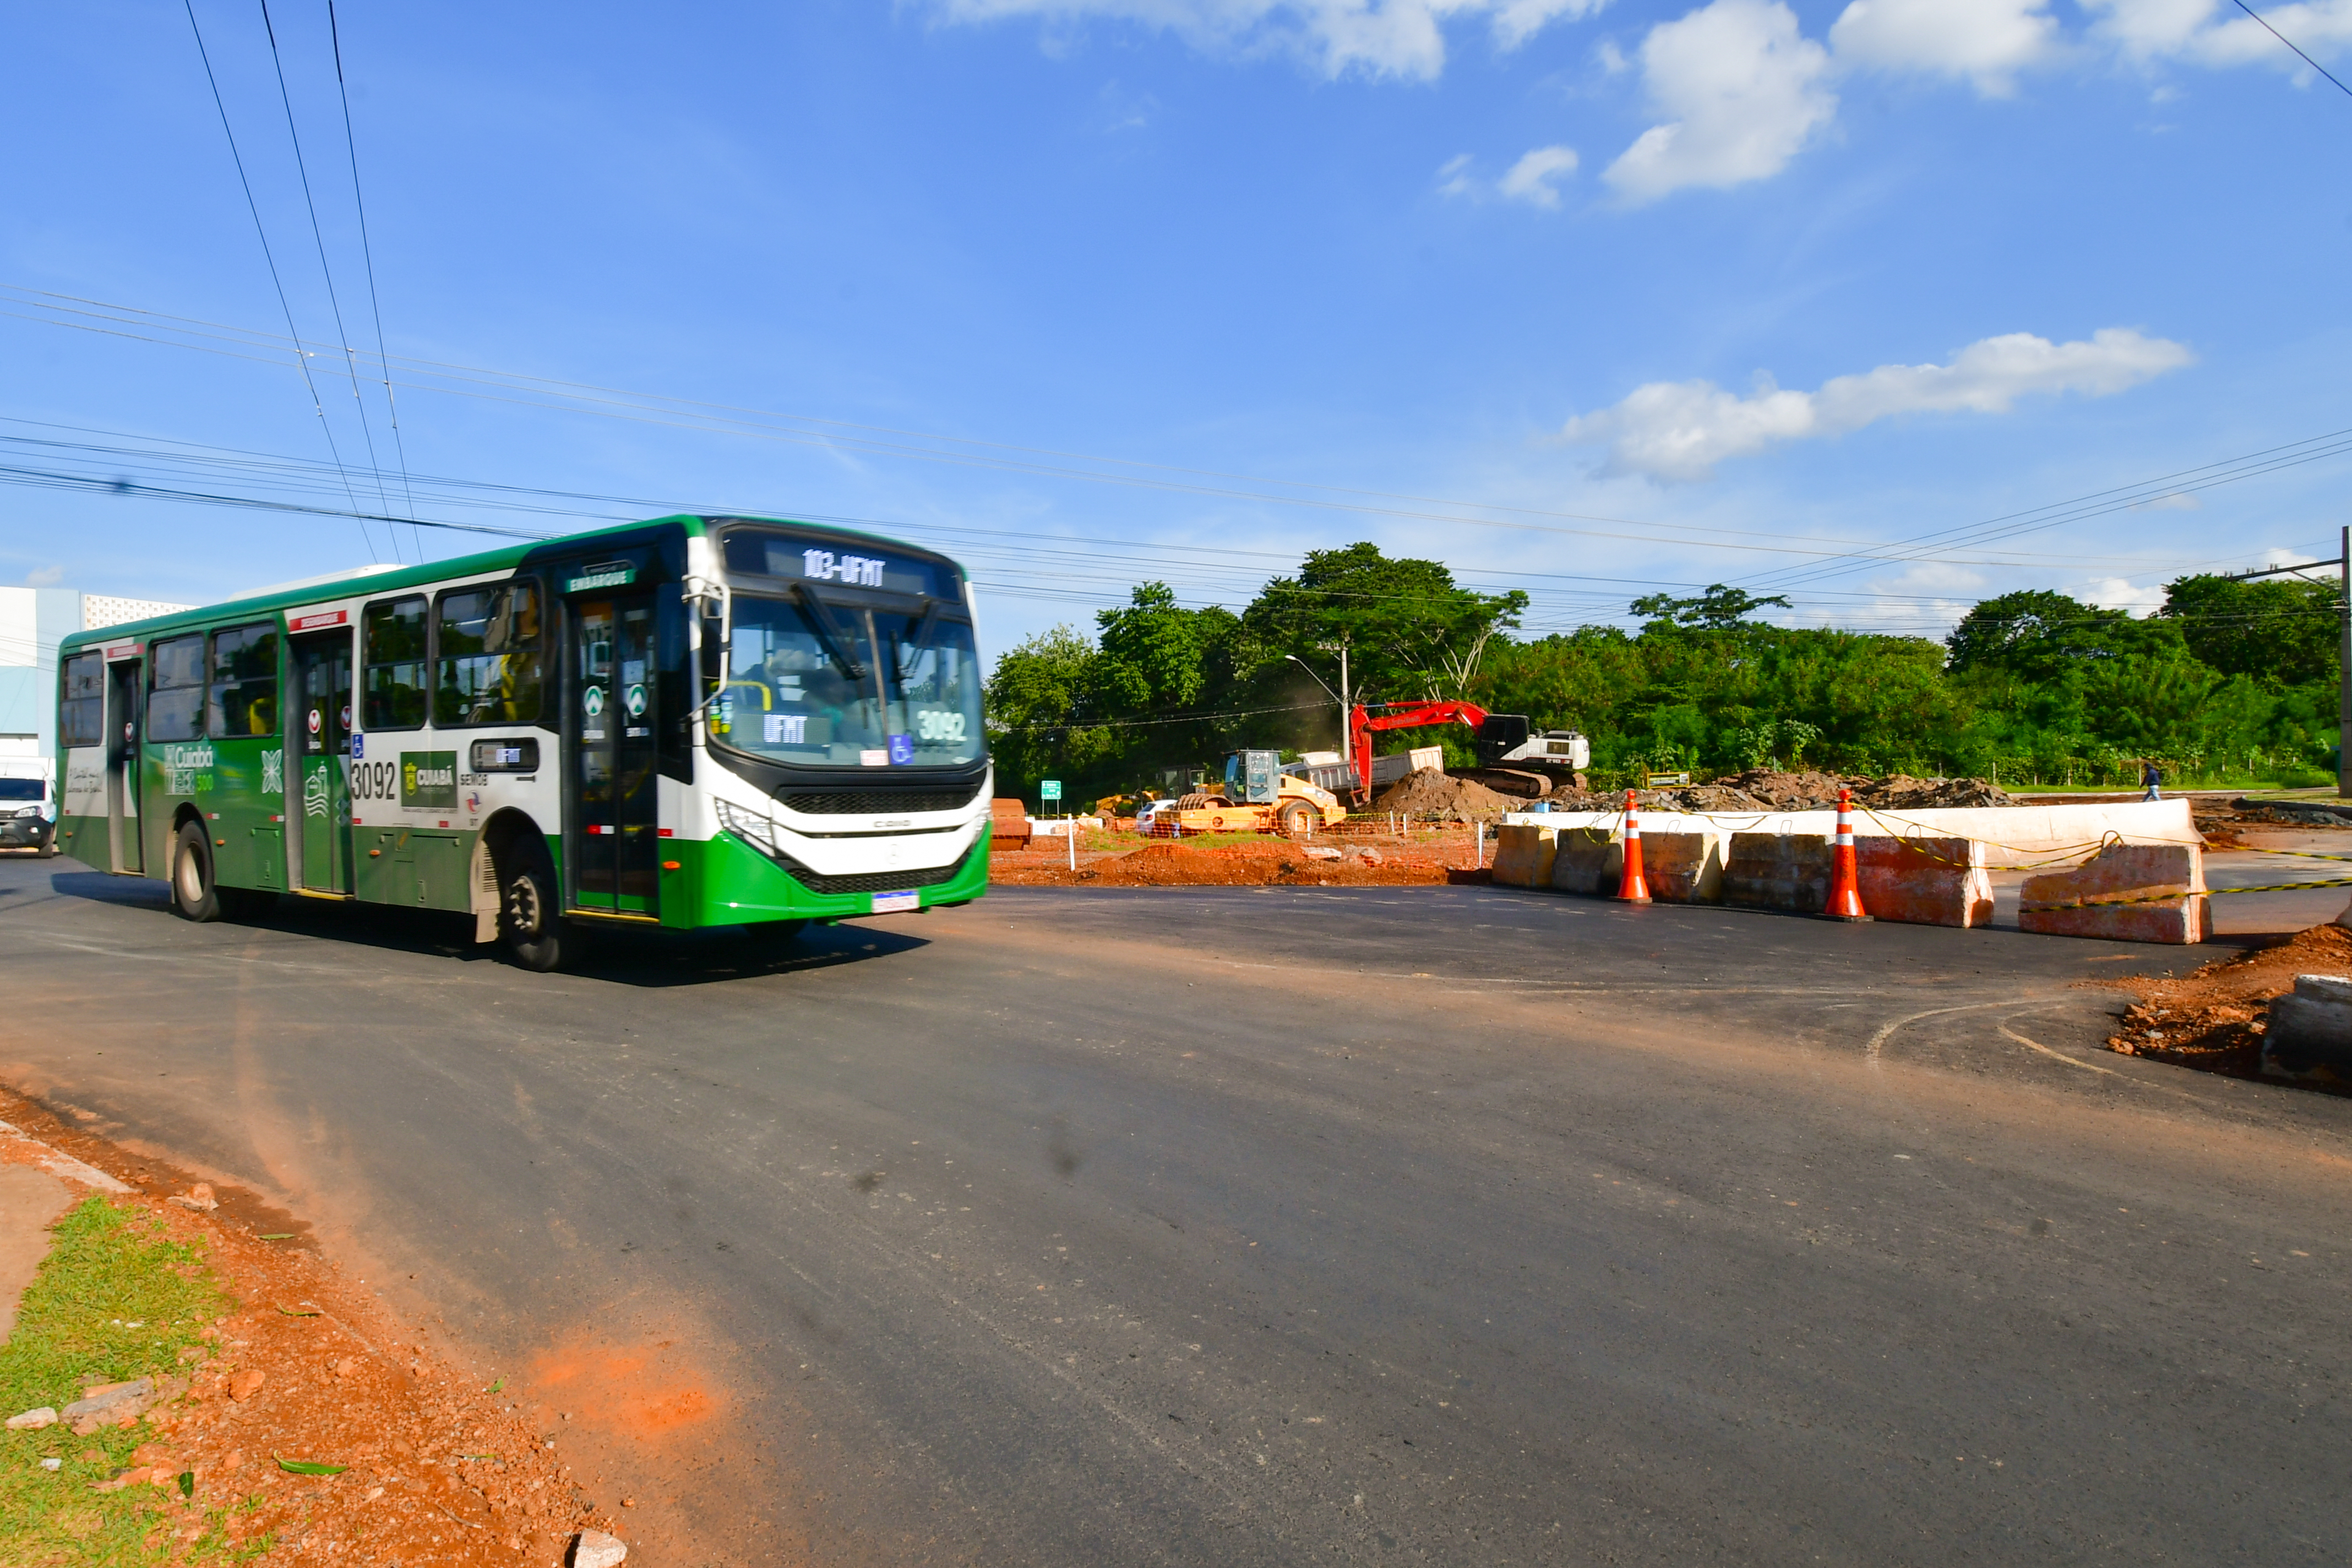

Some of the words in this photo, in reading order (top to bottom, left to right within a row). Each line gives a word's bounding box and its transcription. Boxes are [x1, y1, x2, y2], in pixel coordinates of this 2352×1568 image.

[763, 714, 808, 743] UFMT
[917, 710, 967, 742] 3092
[175, 745, 214, 768] Cuiabá
[351, 761, 395, 799] 3092
[417, 765, 454, 786] CUIABÁ
